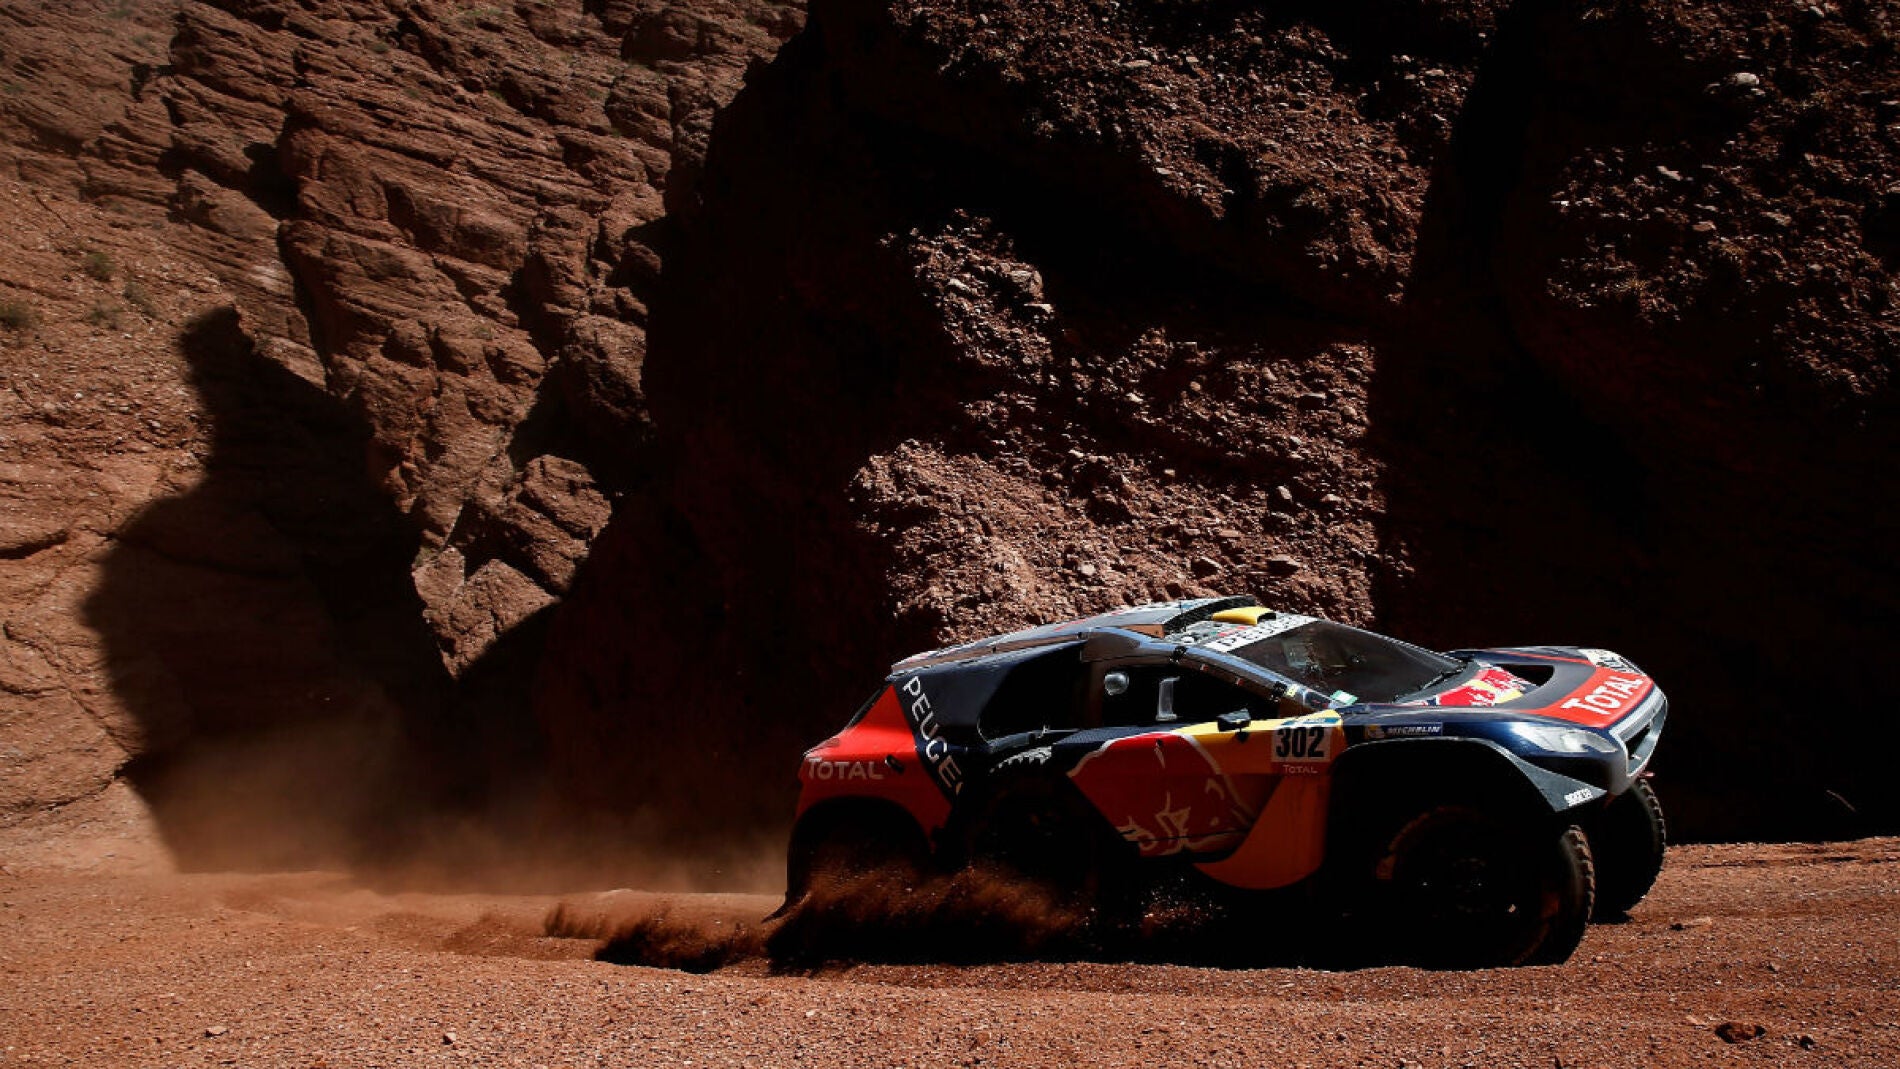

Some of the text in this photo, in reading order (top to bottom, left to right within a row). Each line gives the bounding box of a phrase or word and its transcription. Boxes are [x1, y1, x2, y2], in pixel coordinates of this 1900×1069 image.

[1562, 676, 1643, 715] TOTAL
[1276, 726, 1325, 758] 302
[1387, 726, 1441, 736] MICHELIN
[805, 756, 884, 780] TOTAL
[1283, 764, 1318, 774] TOTAL
